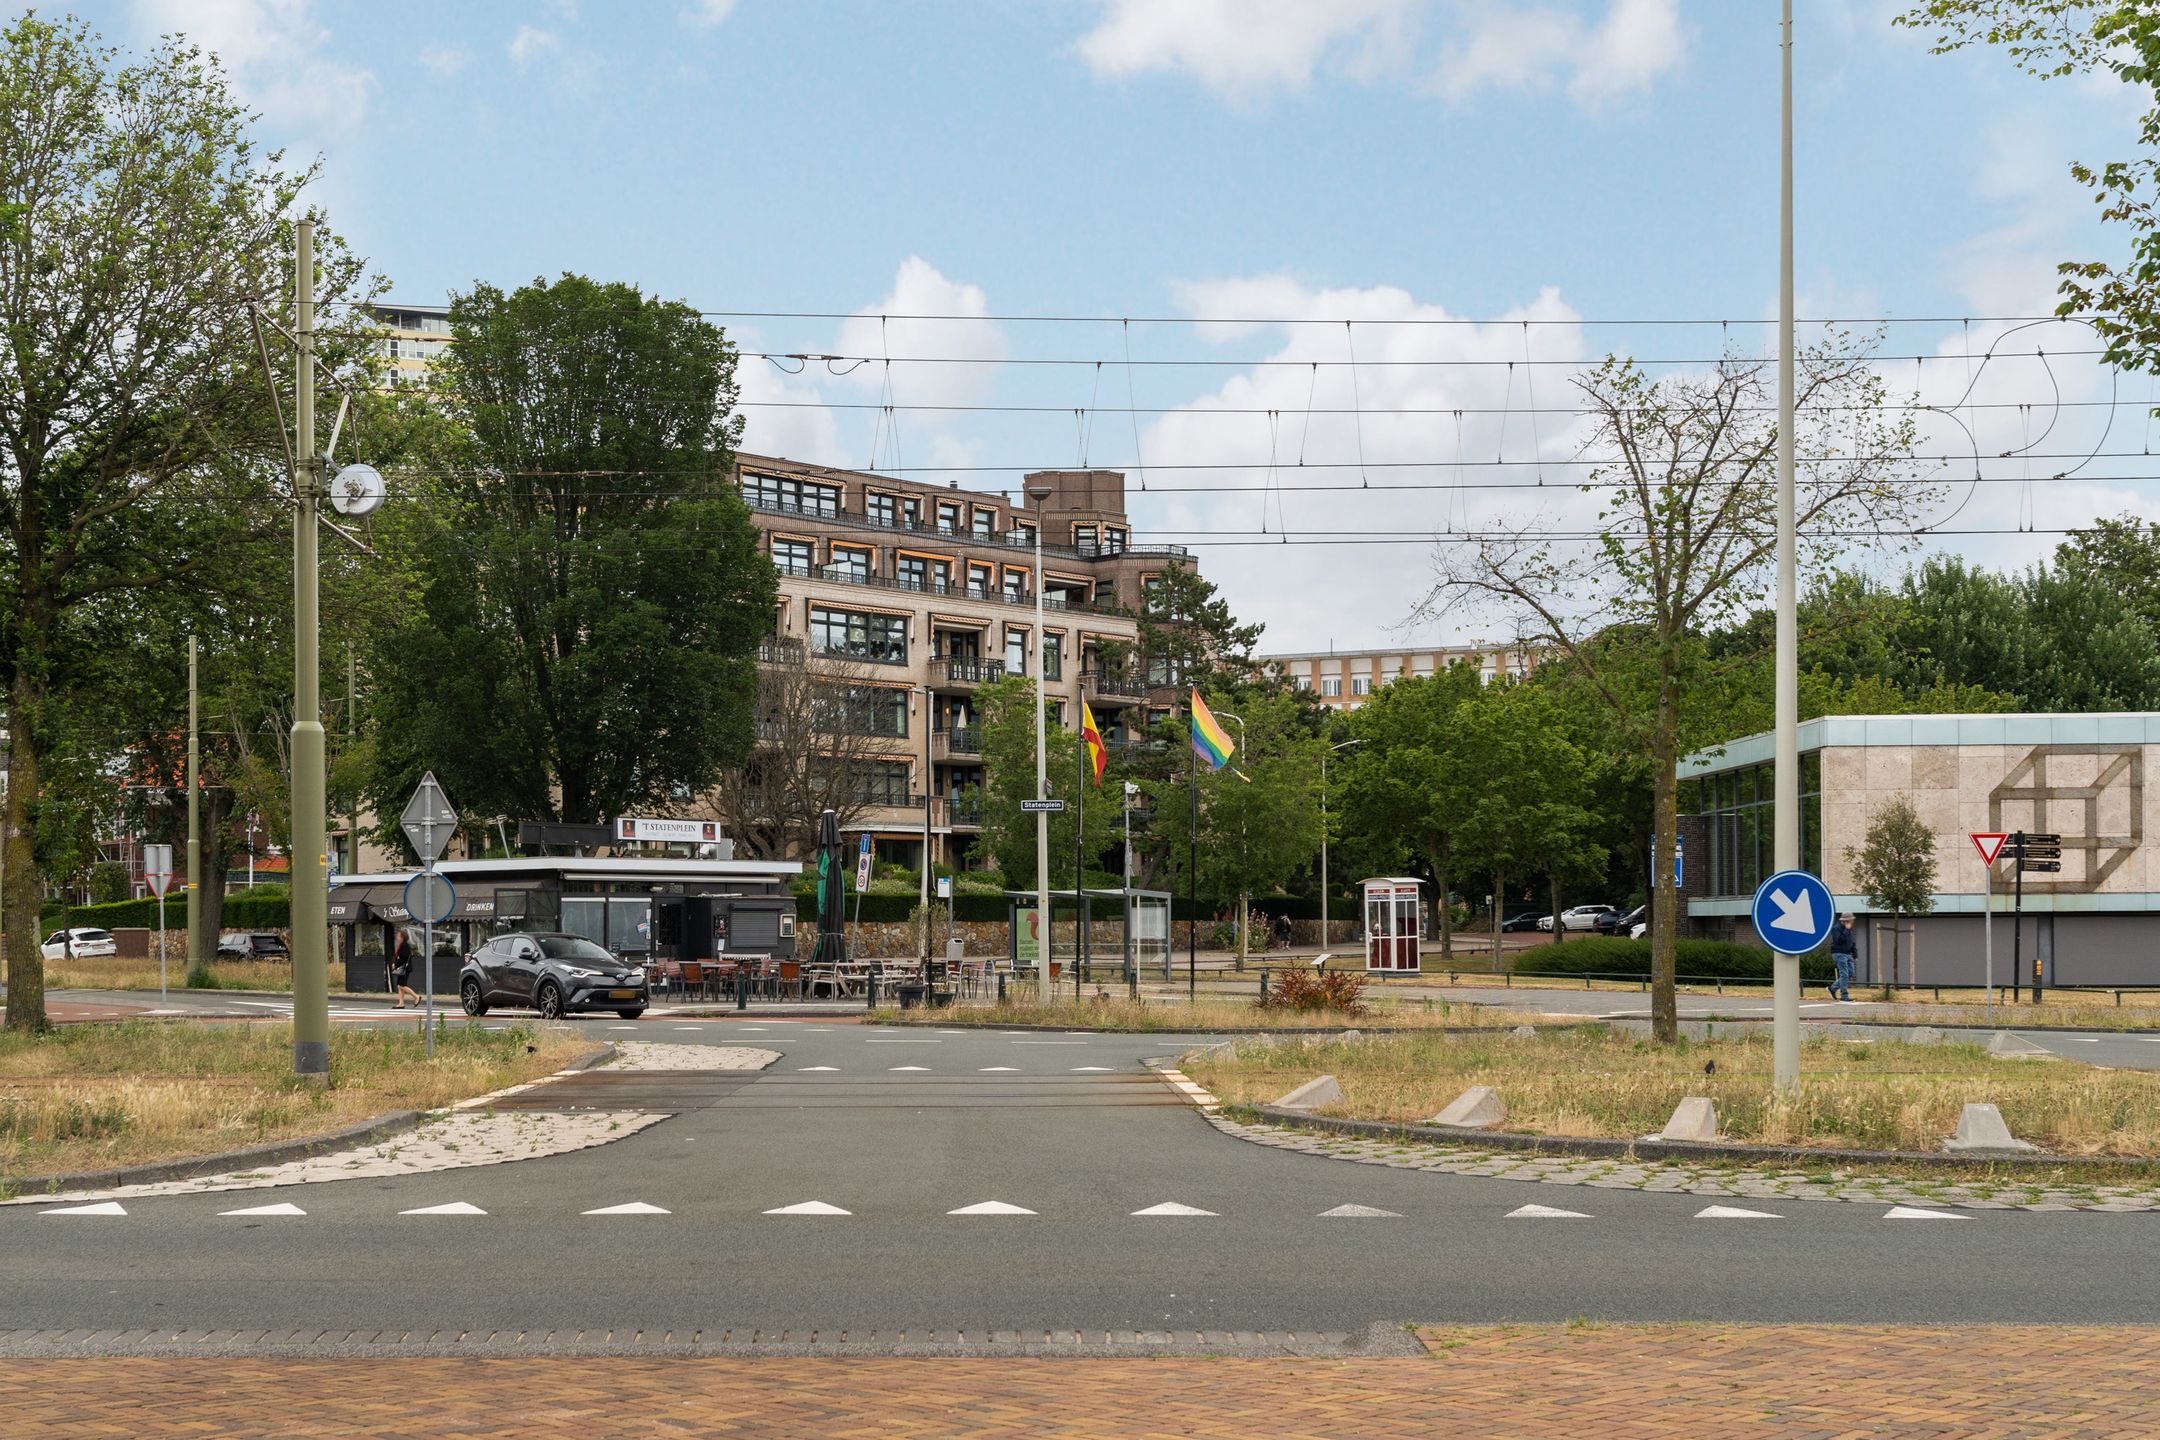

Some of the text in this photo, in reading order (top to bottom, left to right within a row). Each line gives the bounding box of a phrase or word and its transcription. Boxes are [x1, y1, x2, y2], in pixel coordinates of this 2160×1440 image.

[650, 823, 696, 832] STATENPLEIN
[330, 906, 346, 915] ETEN
[466, 902, 494, 911] DRINKEN
